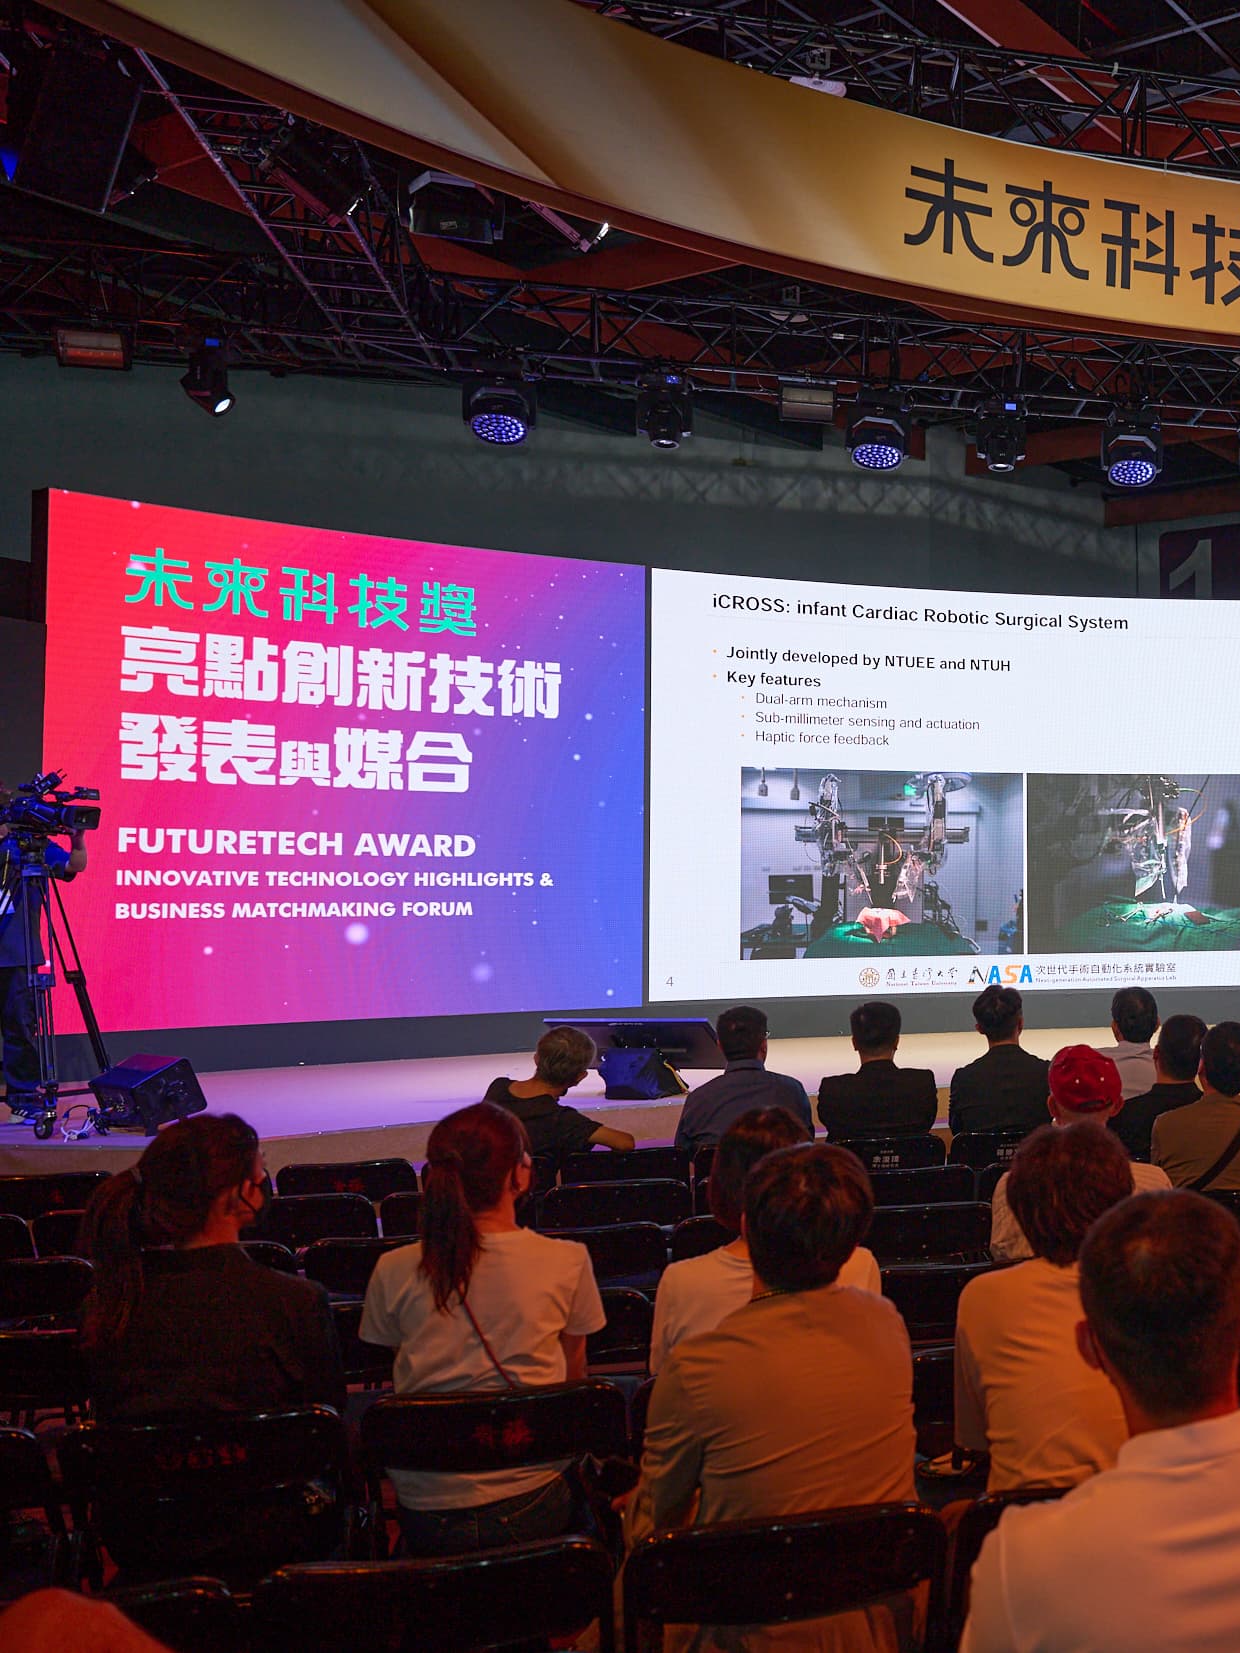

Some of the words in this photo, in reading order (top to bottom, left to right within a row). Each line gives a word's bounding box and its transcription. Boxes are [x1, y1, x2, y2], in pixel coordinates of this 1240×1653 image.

[124, 547, 477, 637] 未來科技獎
[712, 593, 790, 613] iCROSS:
[796, 599, 847, 618] infant
[852, 603, 918, 622] Cardiac
[924, 608, 989, 625] Robotic
[995, 611, 1063, 631] Surgical
[1068, 614, 1129, 632] System
[726, 646, 778, 664] Jointly
[782, 649, 859, 667] developed
[863, 653, 880, 670] by
[885, 655, 935, 669] NTUEE
[939, 659, 966, 671] and
[970, 659, 1011, 672] NTUH
[120, 625, 562, 720] 亮點創新技術
[727, 670, 756, 687] Key
[760, 672, 821, 688] features
[755, 692, 813, 706] Dual-arm
[817, 696, 888, 709] mechanism
[755, 711, 844, 727] Sub-millimeter
[848, 717, 896, 730] sensing
[899, 717, 922, 729] and
[926, 718, 980, 731] actuation
[755, 730, 796, 745] Haptic
[799, 732, 830, 744] force
[834, 733, 890, 746] feedback
[118, 711, 473, 793] 發表與媒合
[117, 826, 344, 856] FUTURETECH
[353, 832, 477, 858] AWARD
[115, 870, 260, 888] INNOVATIVE
[265, 870, 409, 888] TECHNOLOGY
[413, 872, 535, 888] HIGHLIGHTS
[539, 872, 555, 888] &
[114, 902, 226, 920] BUSINESS
[231, 901, 397, 919] MATCHMAKING
[402, 901, 474, 918] FORUM
[665, 976, 674, 987] 4
